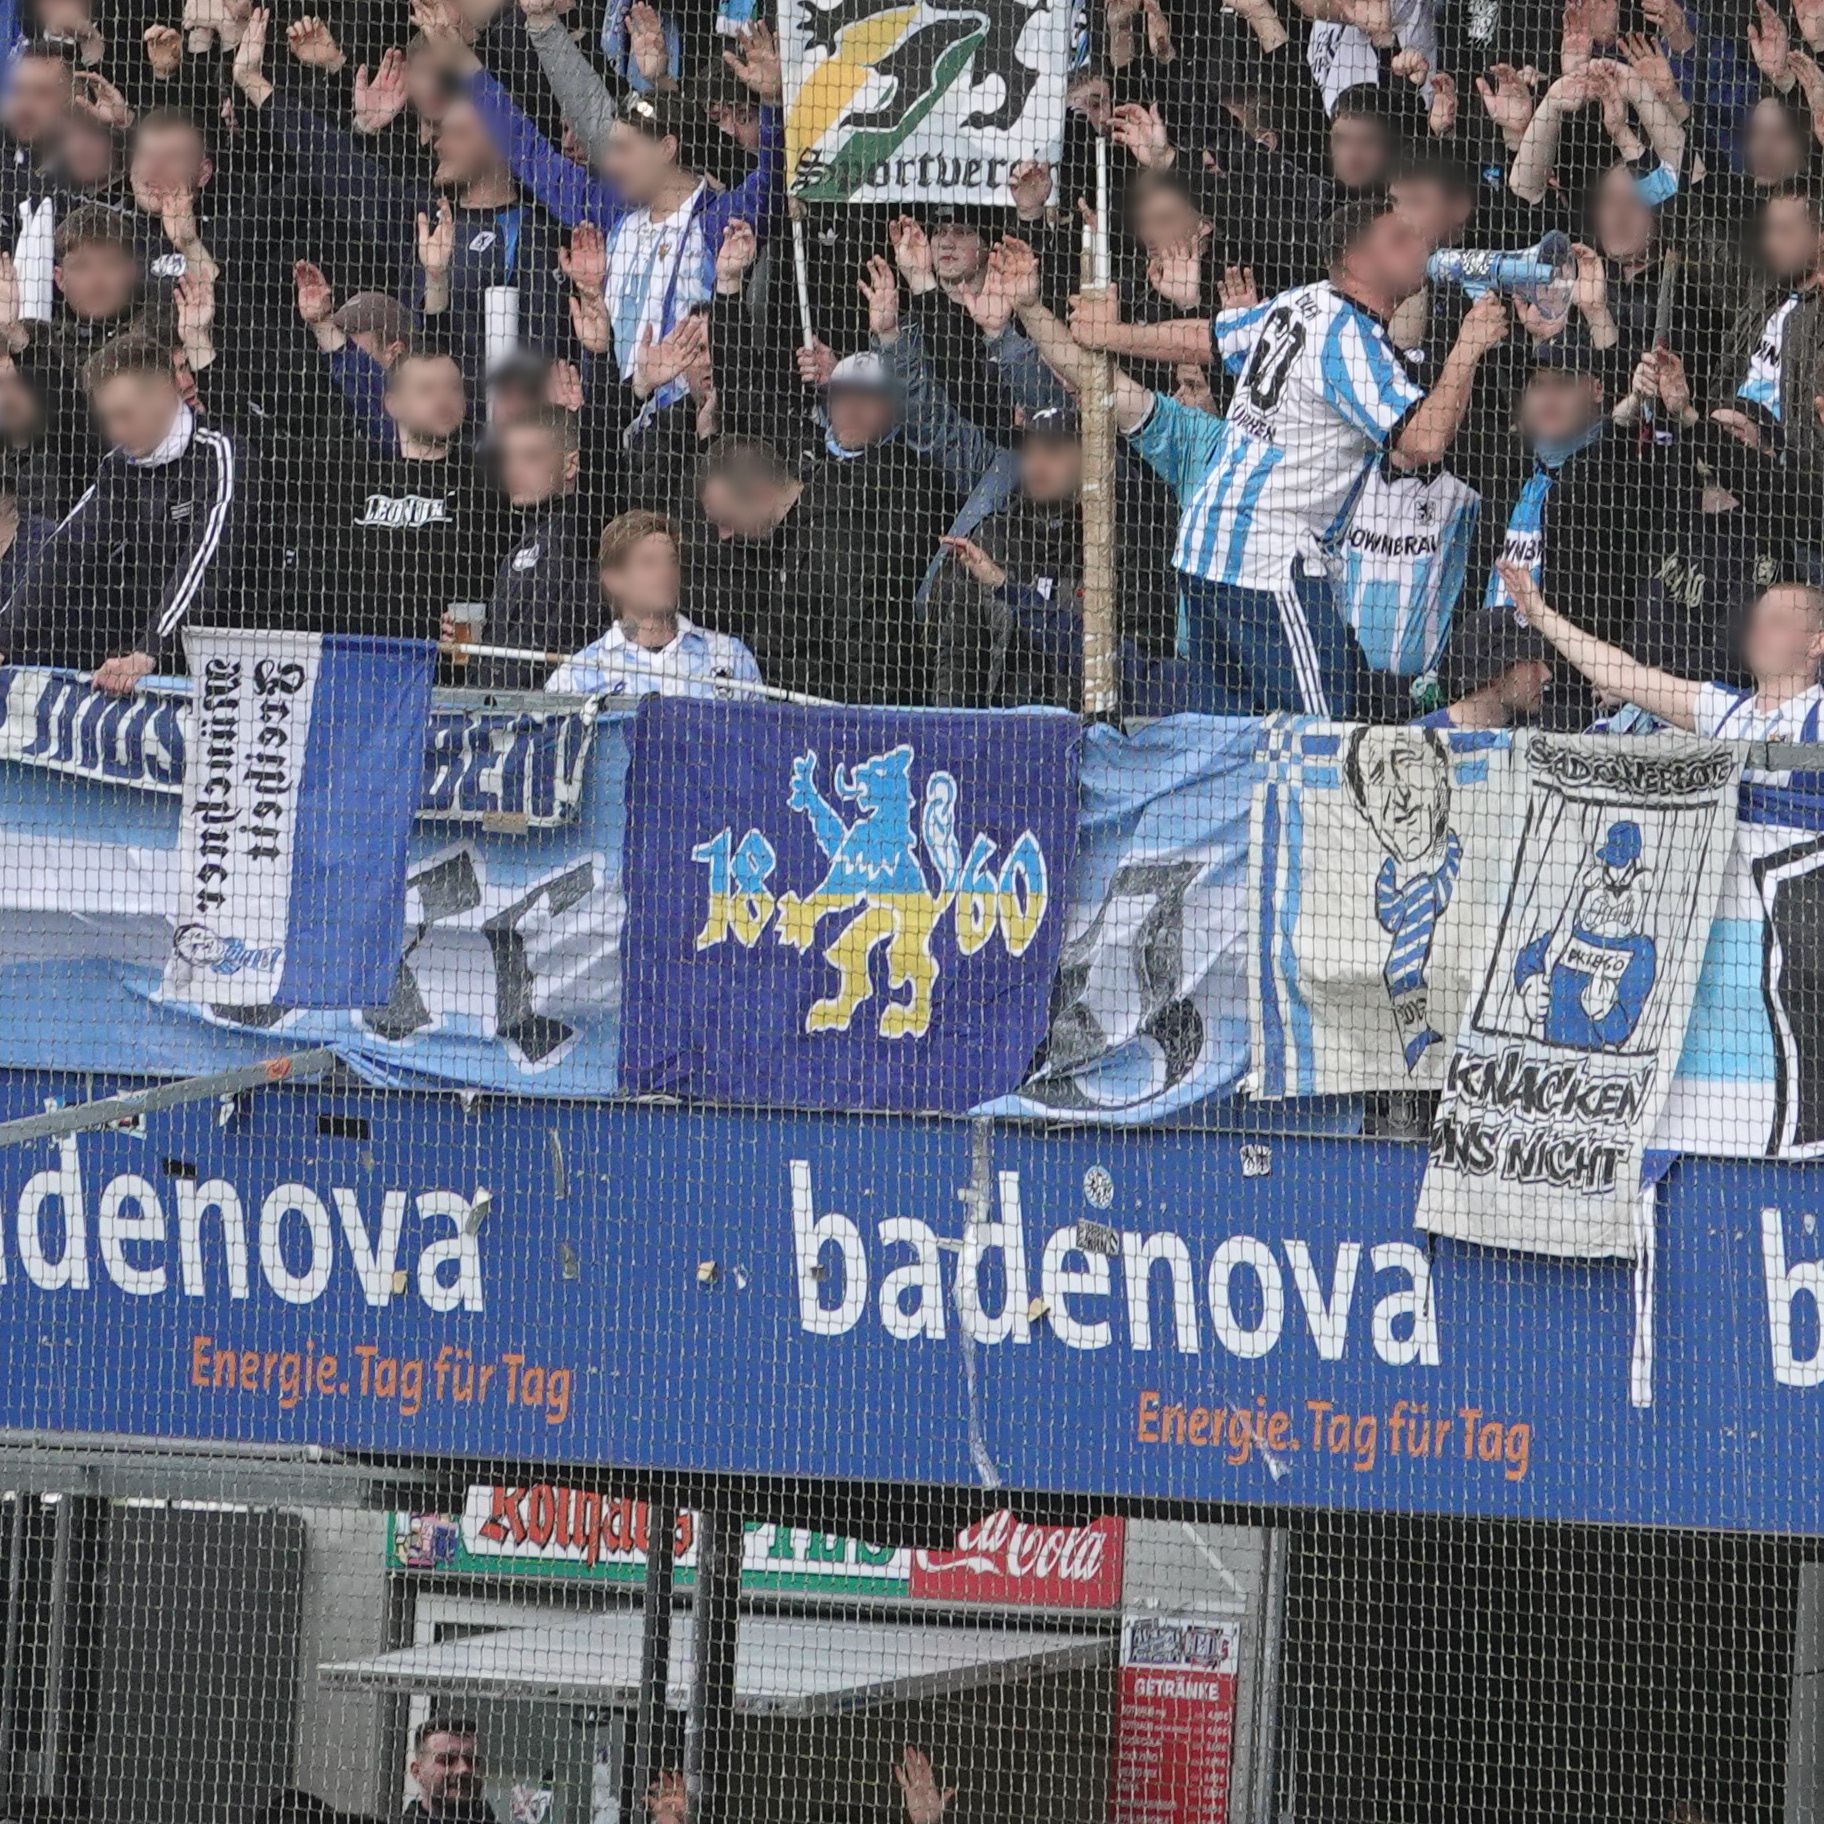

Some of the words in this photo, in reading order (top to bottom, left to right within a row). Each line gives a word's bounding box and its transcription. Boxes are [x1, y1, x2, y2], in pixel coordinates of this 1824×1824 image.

[691, 827, 776, 950] 18
[955, 829, 1047, 956] 60
[1502, 1128, 1630, 1194] NICHT
[789, 1159, 1440, 1367] badenova
[355, 1345, 424, 1417] Tag
[434, 1347, 492, 1405] für
[501, 1353, 571, 1425] Tag
[1307, 1399, 1378, 1472] Tag
[1389, 1401, 1453, 1458] für
[1457, 1409, 1532, 1481] Tag
[1134, 1677, 1219, 1700] GETRÄNKE
